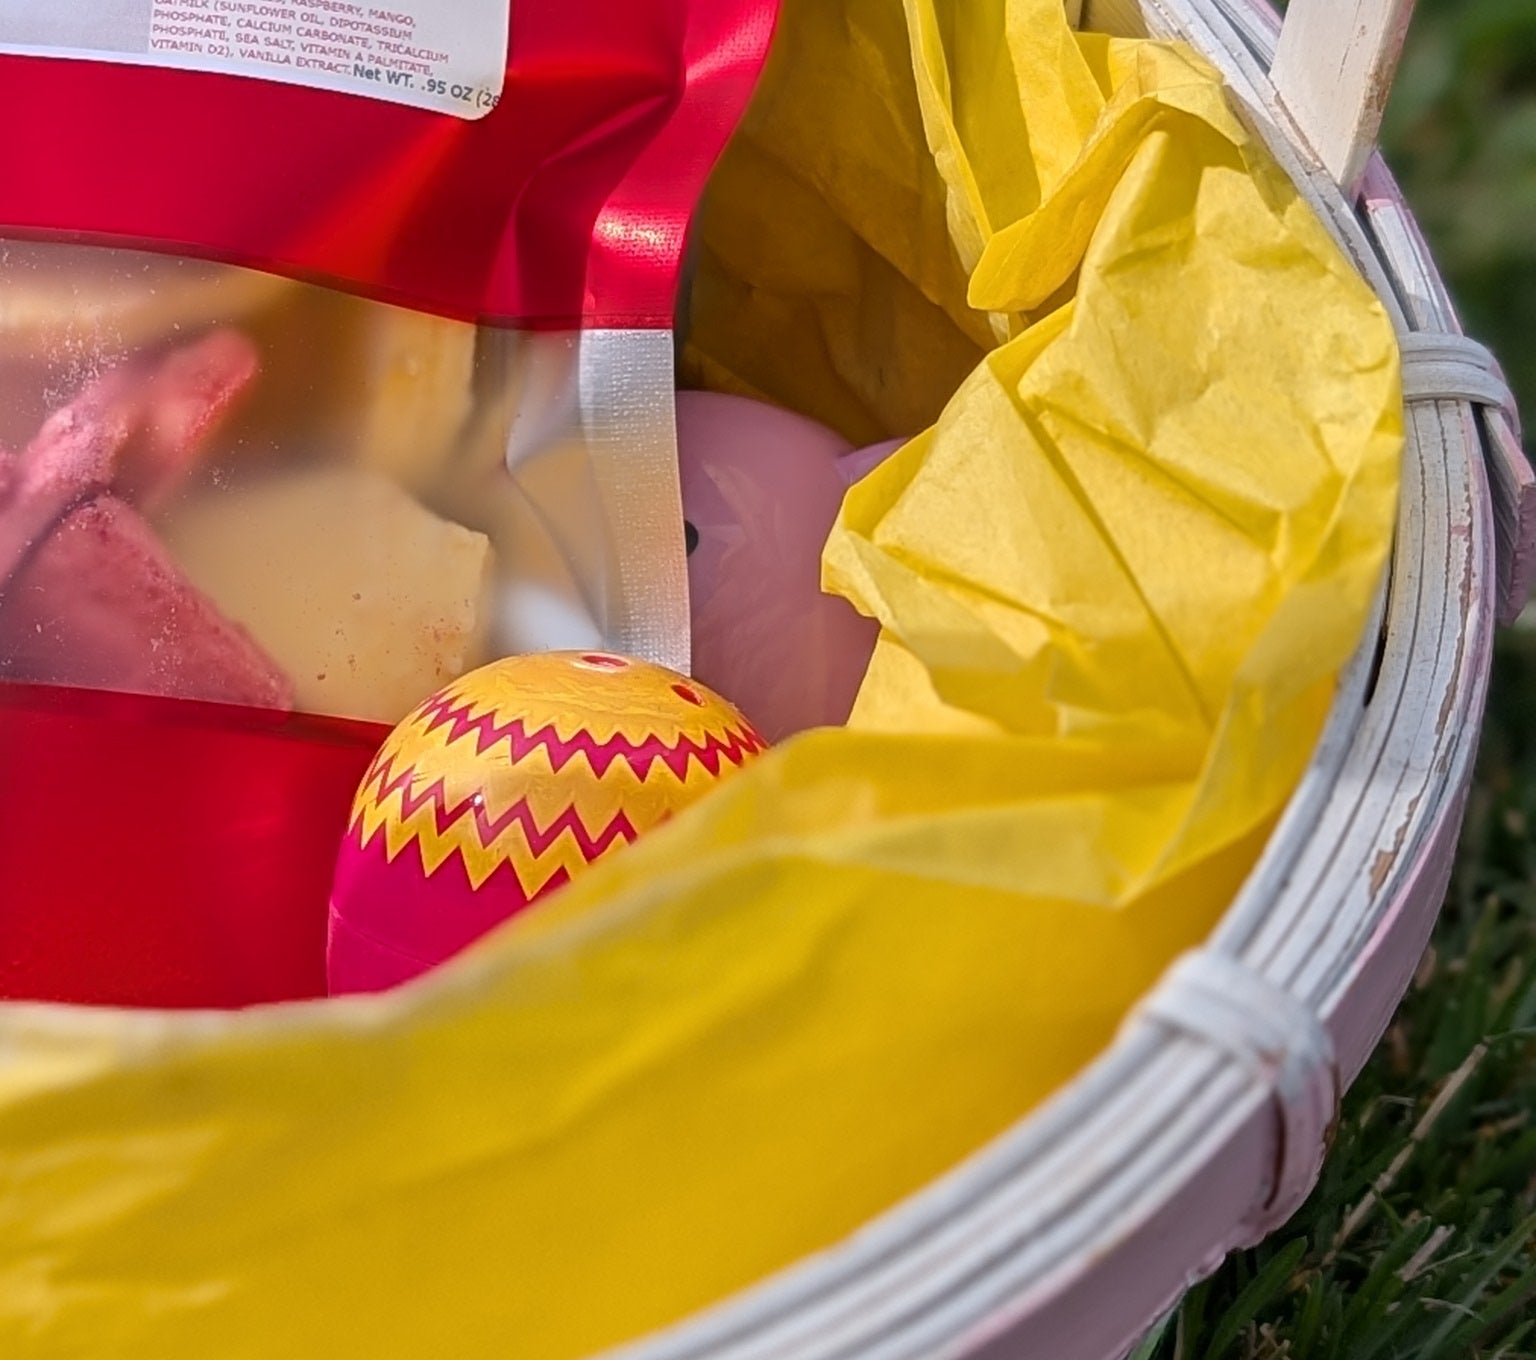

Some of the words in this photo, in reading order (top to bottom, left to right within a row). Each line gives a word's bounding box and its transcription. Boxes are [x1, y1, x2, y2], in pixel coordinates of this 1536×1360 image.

[153, 9, 231, 27] PHOSPHATE,
[236, 18, 292, 34] CALCIUM
[296, 26, 372, 49] CARBONATE,
[377, 40, 449, 63] TRICALCIUM
[213, 0, 296, 20] (SUNFLOWER
[329, 17, 413, 39] DIPOTASSIUM
[368, 8, 416, 28] MANGO,
[151, 39, 202, 53] VITAMIN
[239, 48, 291, 65] VANILLA
[152, 24, 230, 42] PHOSPHATE,
[235, 33, 259, 44] SEA
[264, 38, 295, 52] SALT,
[300, 43, 351, 60] VITAMIN
[354, 52, 364, 62] A
[367, 57, 433, 77] PALMITATE,
[353, 64, 381, 81] Net
[386, 70, 414, 88] WT.
[421, 79, 447, 95] .95
[450, 84, 473, 101] OZ
